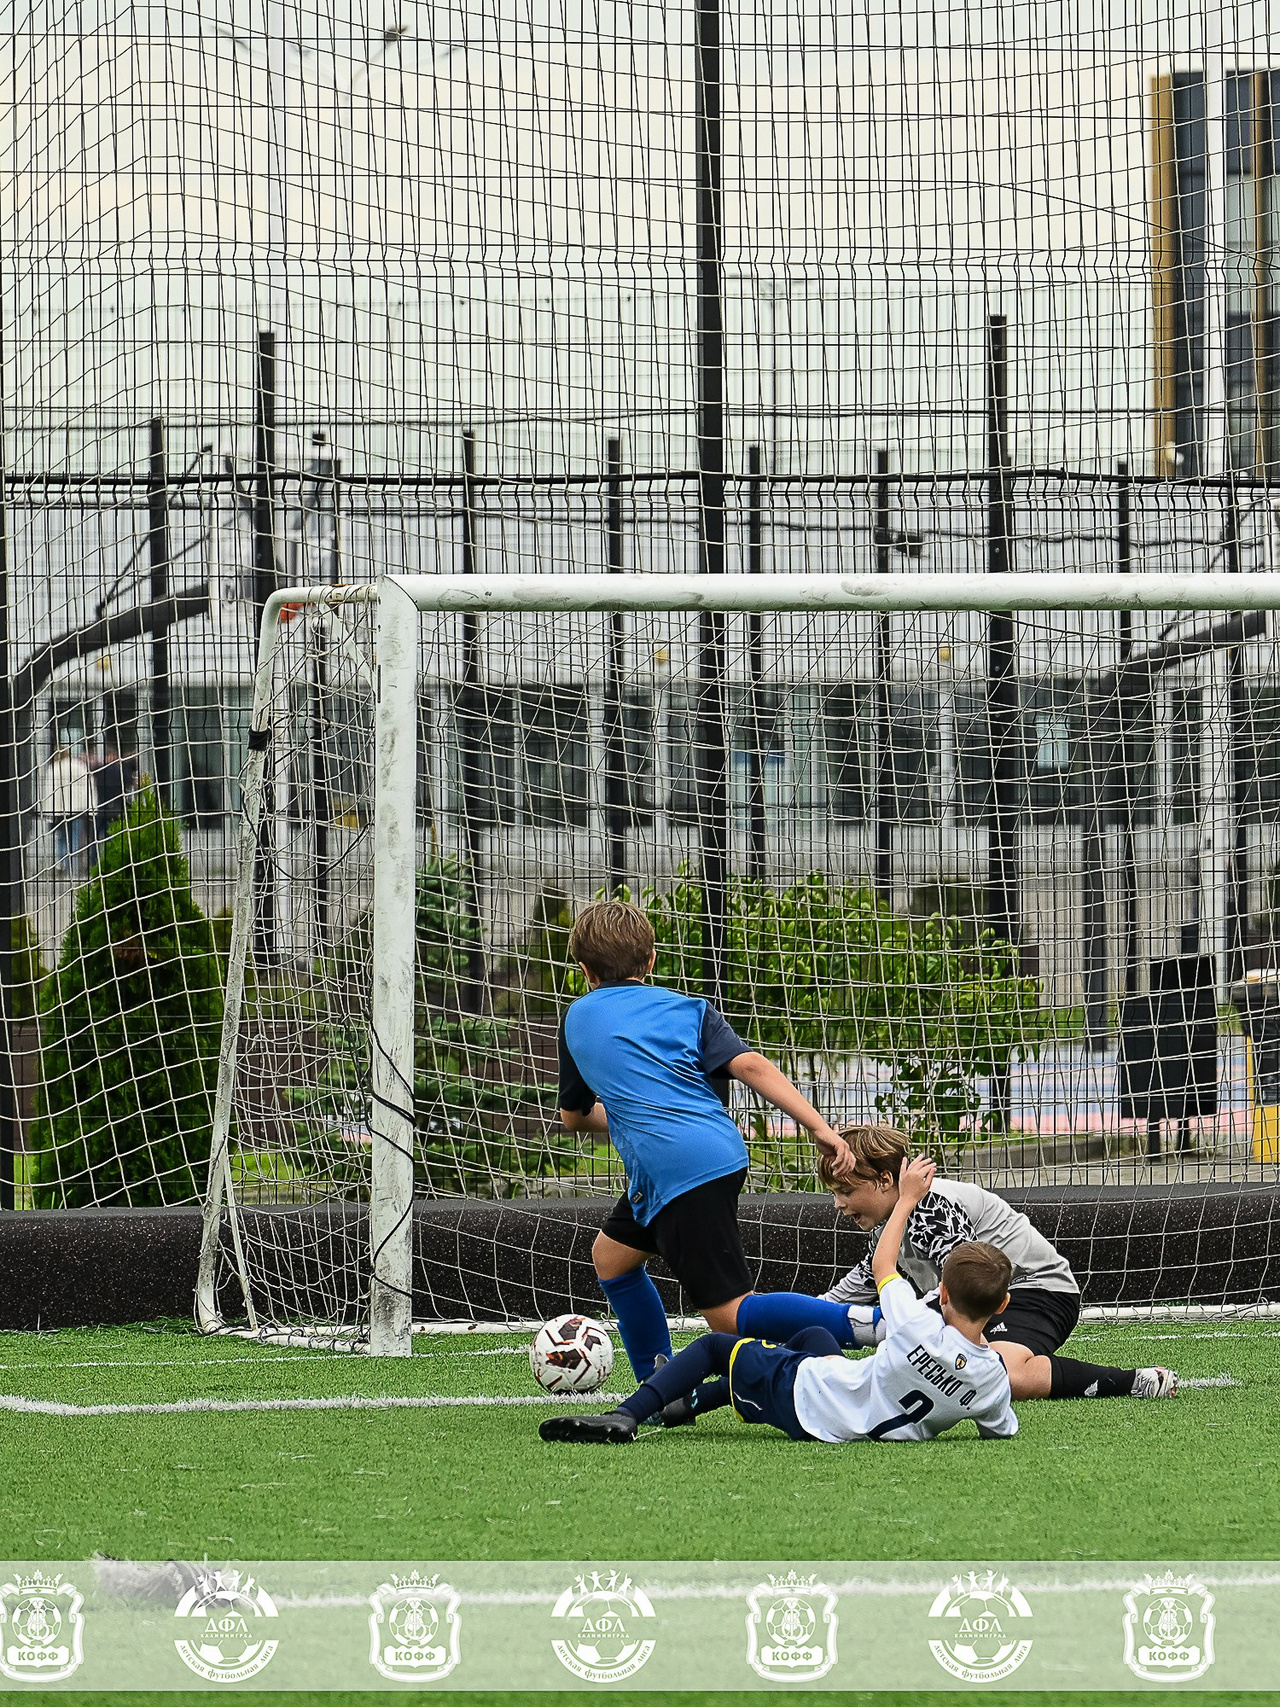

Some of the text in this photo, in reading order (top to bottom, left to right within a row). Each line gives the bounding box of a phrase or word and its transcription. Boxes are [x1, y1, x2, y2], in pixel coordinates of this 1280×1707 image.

[906, 1344, 977, 1411] ЕРЕСЬКО Ф.
[866, 1389, 934, 1440] 2
